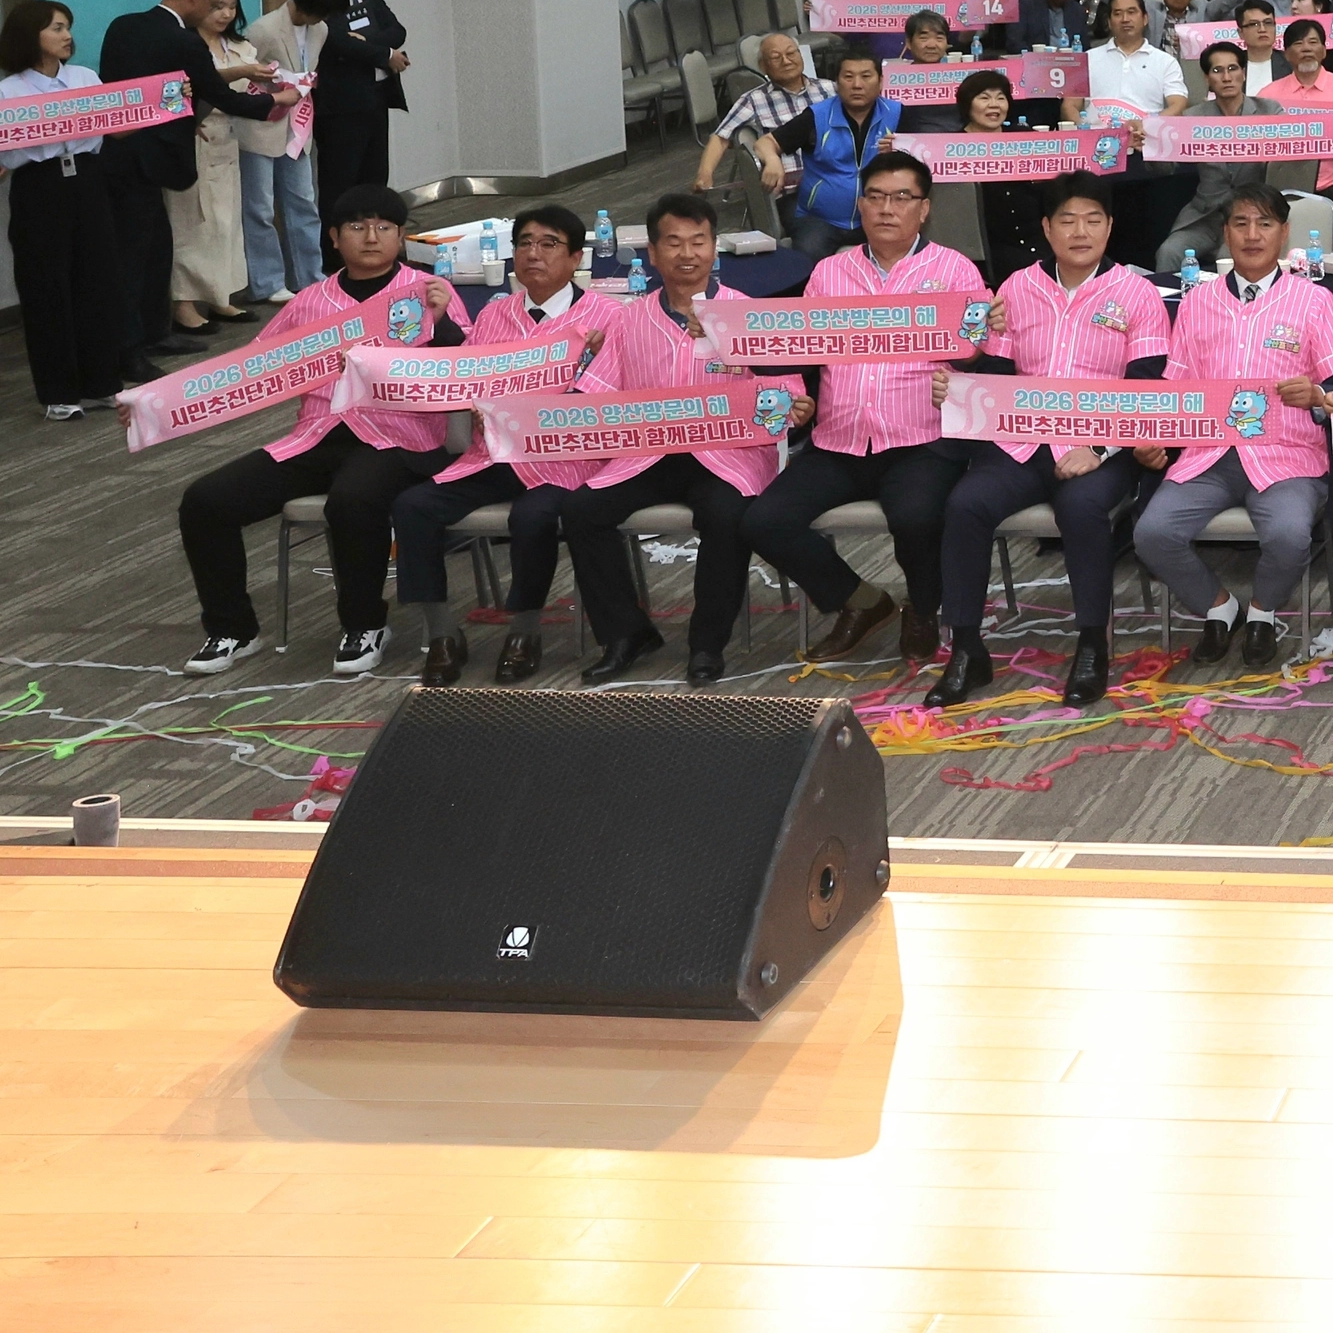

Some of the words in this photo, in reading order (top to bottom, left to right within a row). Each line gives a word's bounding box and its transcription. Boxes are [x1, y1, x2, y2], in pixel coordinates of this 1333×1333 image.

[982, 0, 1004, 16] 14
[1049, 68, 1066, 88] 9
[43, 92, 124, 117] 양산방문의
[126, 88, 143, 105] 해
[76, 105, 160, 136] 함께합니다.
[1193, 125, 1232, 140] 2026
[1236, 123, 1305, 139] 양산방문의
[1308, 123, 1323, 137] 해
[1179, 140, 1260, 156] 시민추진단과
[746, 311, 803, 333] 2026
[808, 308, 909, 332] 양산방문의
[914, 308, 936, 329] 해
[729, 333, 845, 356] 시민추진단과
[850, 330, 957, 353] 함께합니다.
[183, 365, 241, 399] 2026
[244, 329, 341, 377] 양산방문의
[344, 317, 364, 341] 해
[388, 358, 451, 379] 2026
[456, 348, 545, 378] 양산방문의
[541, 342, 568, 365] 해
[373, 379, 485, 403] 시민추진단과
[1015, 390, 1071, 412] 2026
[1076, 391, 1177, 414] 양산방문의
[1182, 393, 1204, 414] 해
[170, 383, 285, 430] 시민추진단과
[538, 407, 597, 430] 2026
[601, 400, 704, 426] 양산방문의
[707, 398, 730, 419] 해
[522, 426, 641, 453] 시민추진단과
[645, 418, 752, 445] 함께합니다.
[996, 413, 1111, 436] 시민추진단과
[1117, 415, 1224, 439] 함께합니다.
[499, 948, 529, 958] TPA
